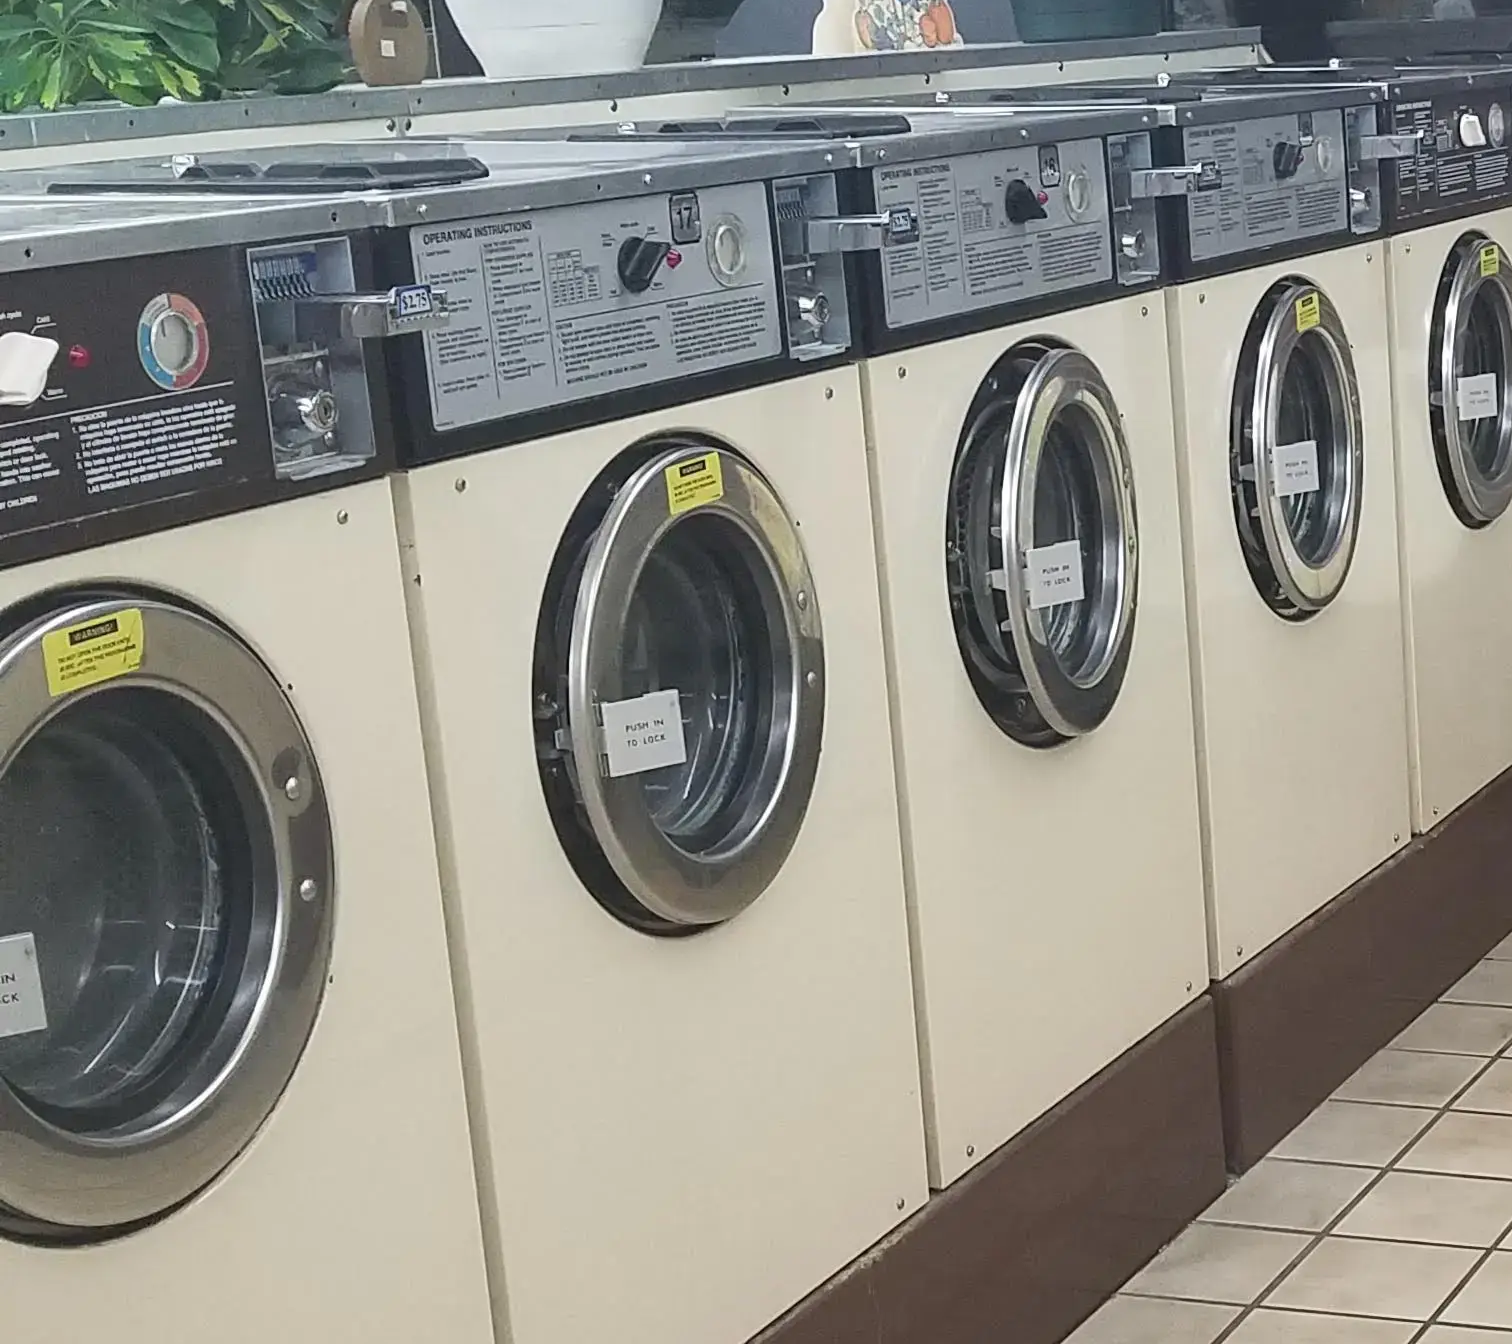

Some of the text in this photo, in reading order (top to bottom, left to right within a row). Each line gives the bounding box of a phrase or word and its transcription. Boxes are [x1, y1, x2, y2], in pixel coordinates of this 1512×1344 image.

[676, 206, 692, 229] 17
[423, 219, 533, 245] OPERATING INSTRUCTIONS
[625, 719, 665, 733] PUSH IN
[627, 734, 666, 747] TO LOCK
[0, 992, 19, 1004] CK
